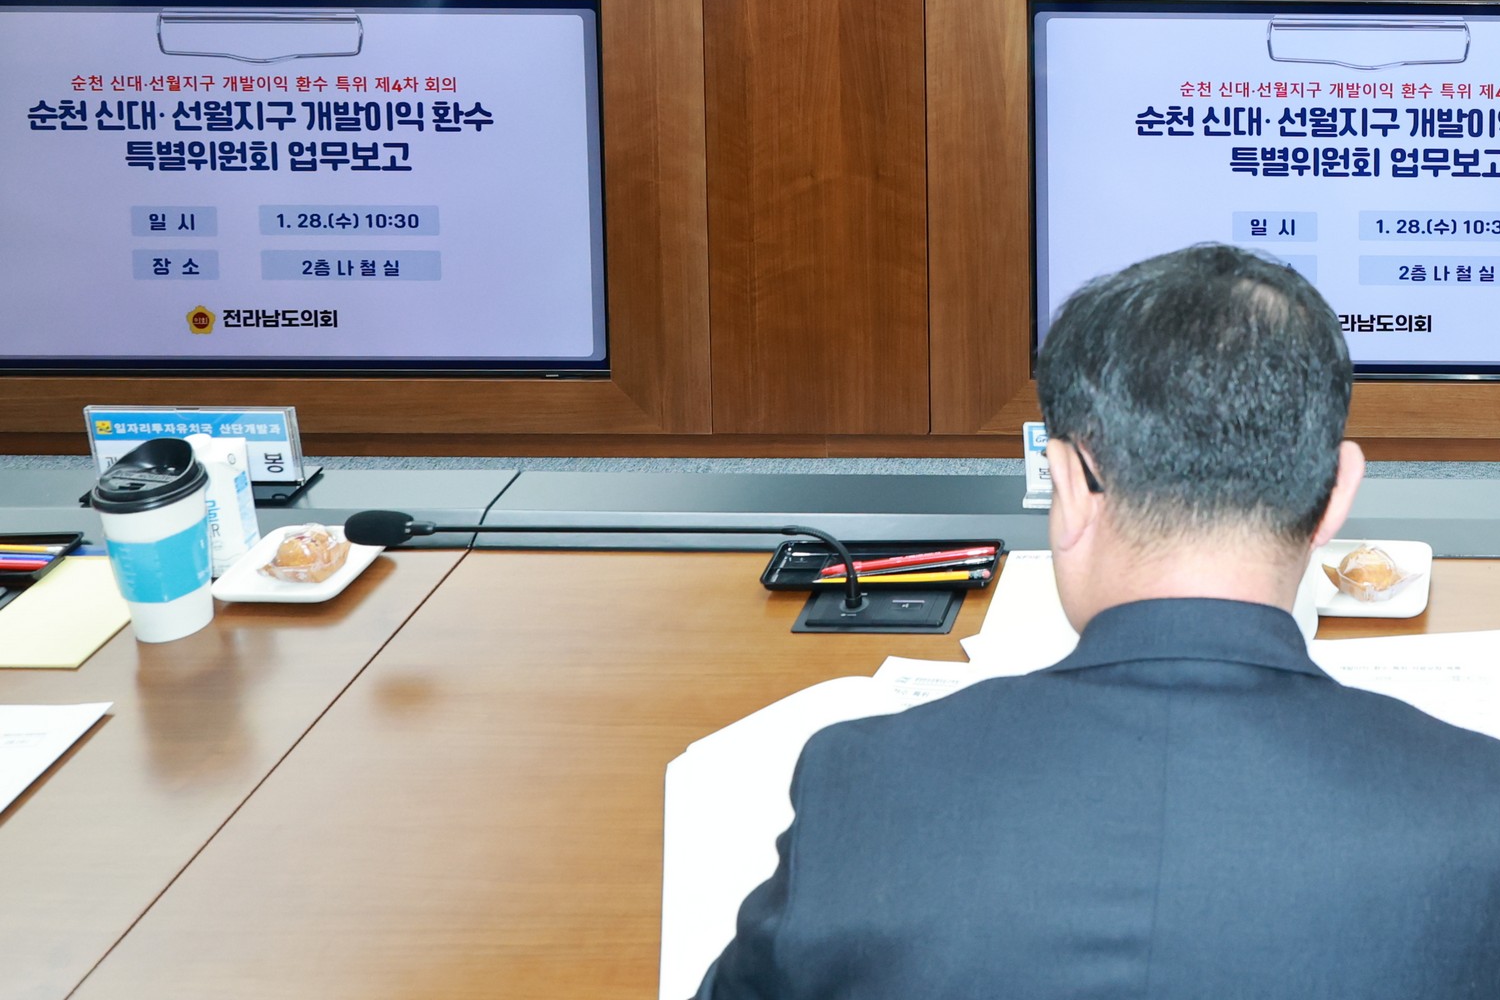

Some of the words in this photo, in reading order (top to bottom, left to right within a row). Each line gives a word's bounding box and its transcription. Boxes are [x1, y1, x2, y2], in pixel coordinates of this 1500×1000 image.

[71, 75, 103, 91] 순천
[111, 76, 215, 91] 신대·선월지구
[223, 76, 287, 92] 개발이익
[296, 76, 328, 92] 환수
[336, 76, 366, 92] 특위
[375, 77, 418, 92] 제4차
[425, 77, 456, 92] 회의
[1180, 82, 1211, 97] 순천
[1219, 82, 1321, 98] 신대·선월지구
[1330, 83, 1392, 98] 개발이익
[1402, 83, 1432, 99] 환수
[1441, 84, 1470, 99] 특위
[28, 100, 88, 130] 순천
[304, 101, 424, 131] 개발이익
[432, 101, 494, 132] 환수
[1135, 106, 1194, 136] 순천
[125, 141, 279, 171] 특별위원회
[288, 142, 412, 171] 업무보고
[1230, 147, 1380, 178] 특별위원회
[277, 214, 291, 228] 1.
[366, 214, 418, 228] 10:30
[1376, 220, 1389, 233] 1.
[303, 260, 330, 276] 2층
[1399, 265, 1426, 281] 2층
[223, 310, 337, 327] 전라남도의회
[1340, 315, 1431, 332] 라남도의회
[114, 423, 213, 435] 일자리투자유치국
[219, 424, 281, 435] 산단개발과
